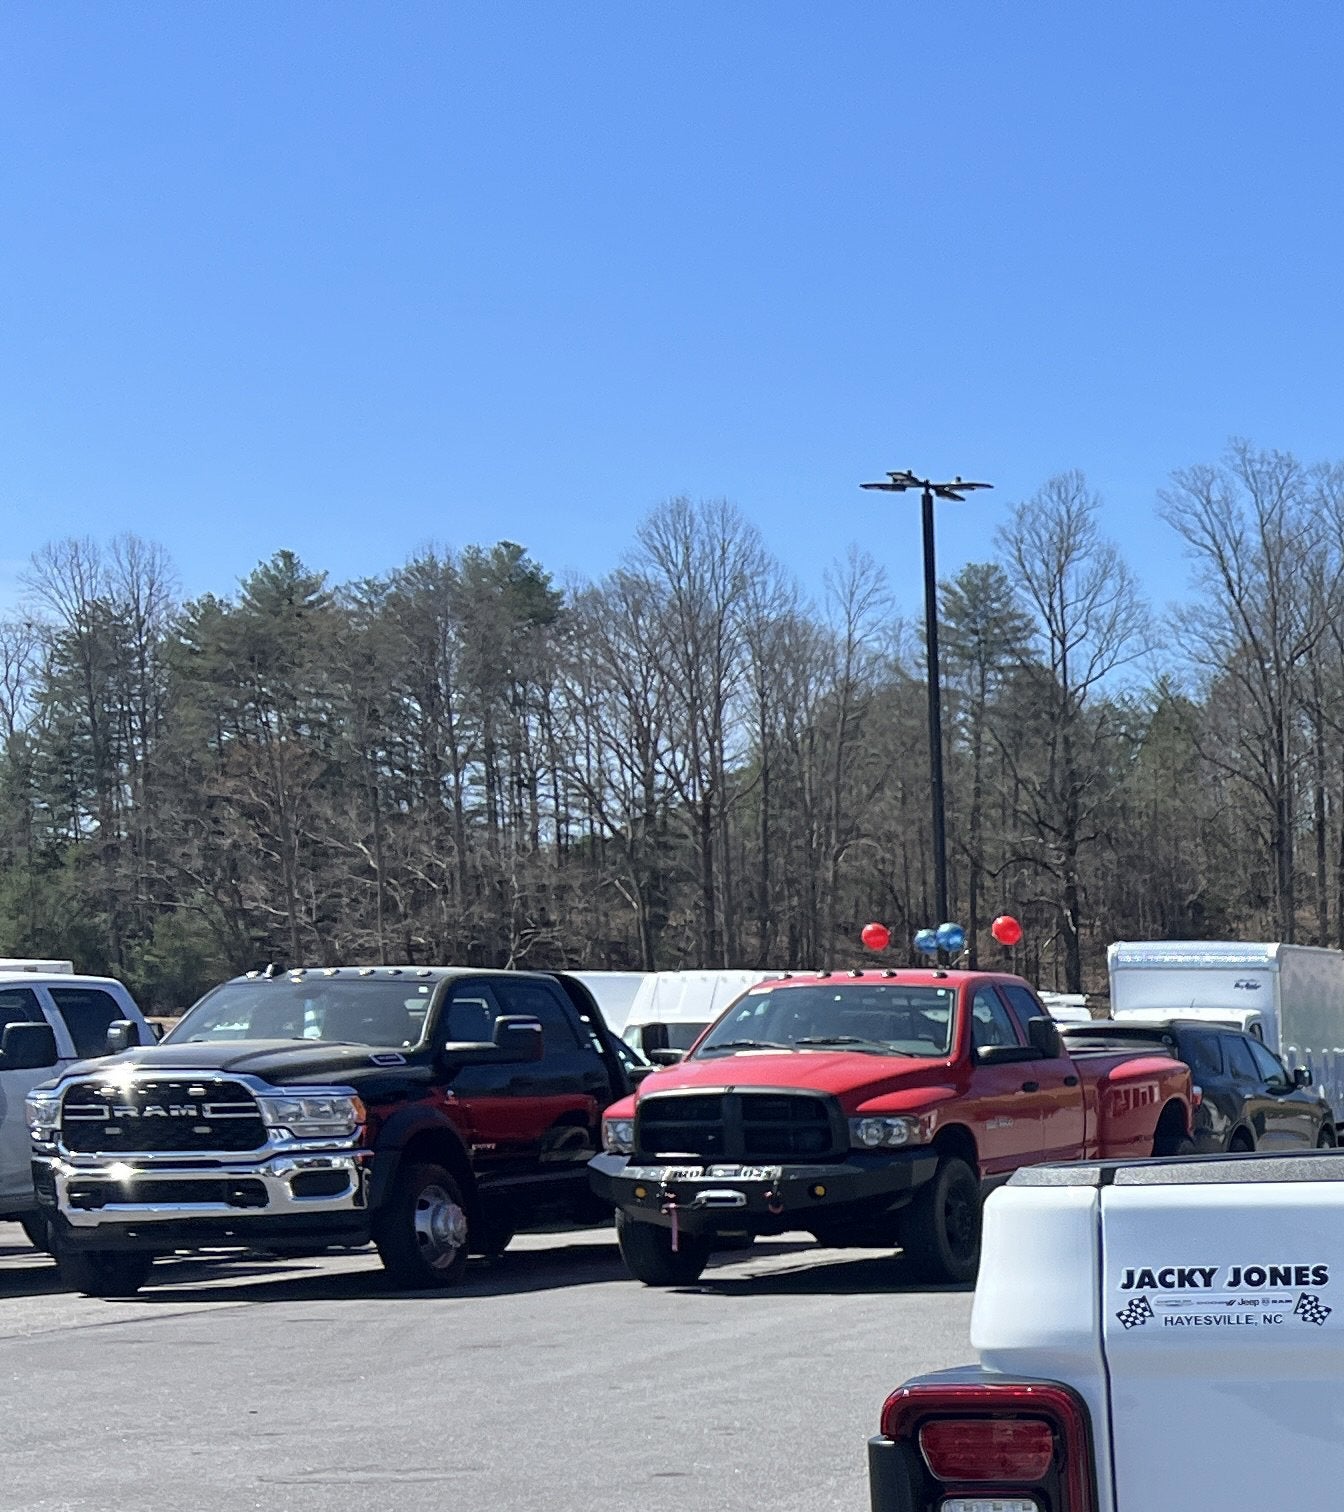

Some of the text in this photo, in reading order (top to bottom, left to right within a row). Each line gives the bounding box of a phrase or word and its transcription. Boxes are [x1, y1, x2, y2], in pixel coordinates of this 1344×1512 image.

[113, 1104, 198, 1118] RAM
[1120, 1264, 1329, 1290] JACKY JONES
[1237, 1298, 1260, 1307] Jeep
[1164, 1314, 1284, 1327] HAYESVILLE, NC
